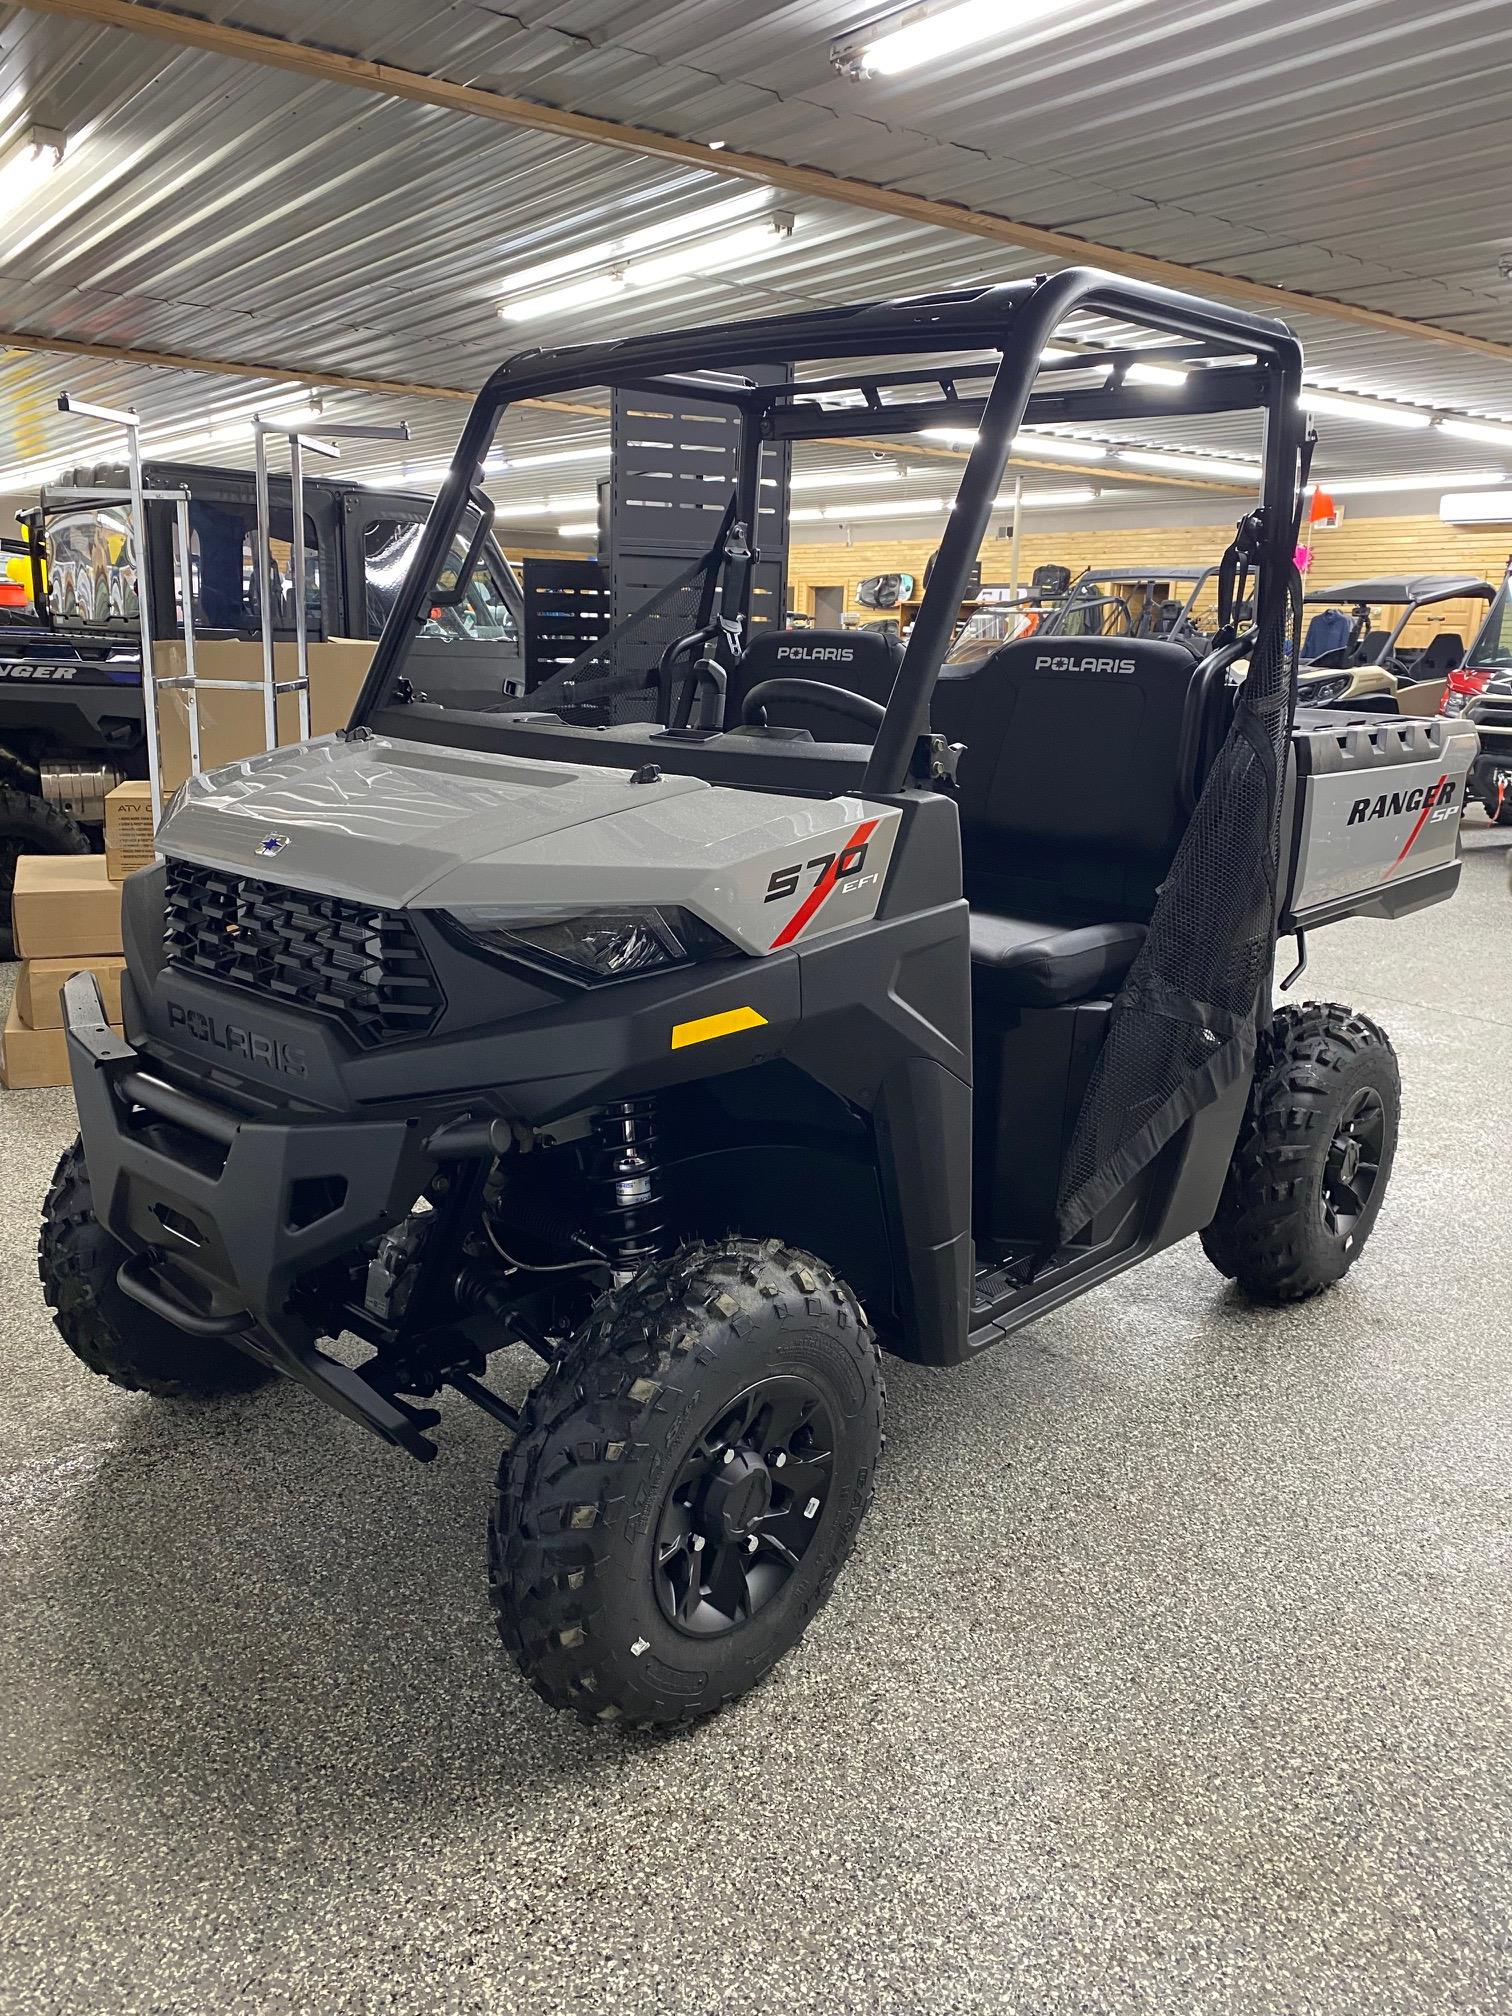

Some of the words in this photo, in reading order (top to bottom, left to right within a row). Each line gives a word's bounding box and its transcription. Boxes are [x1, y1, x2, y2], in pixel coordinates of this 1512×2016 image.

[777, 647, 854, 662] POLARIS
[1035, 656, 1136, 674] POLARIS
[117, 804, 141, 812] ATV
[1346, 781, 1457, 826] RANGER
[1430, 805, 1460, 824] SP
[763, 842, 869, 904] 570
[841, 872, 879, 894] EFI
[167, 1000, 308, 1078] POLARIS
